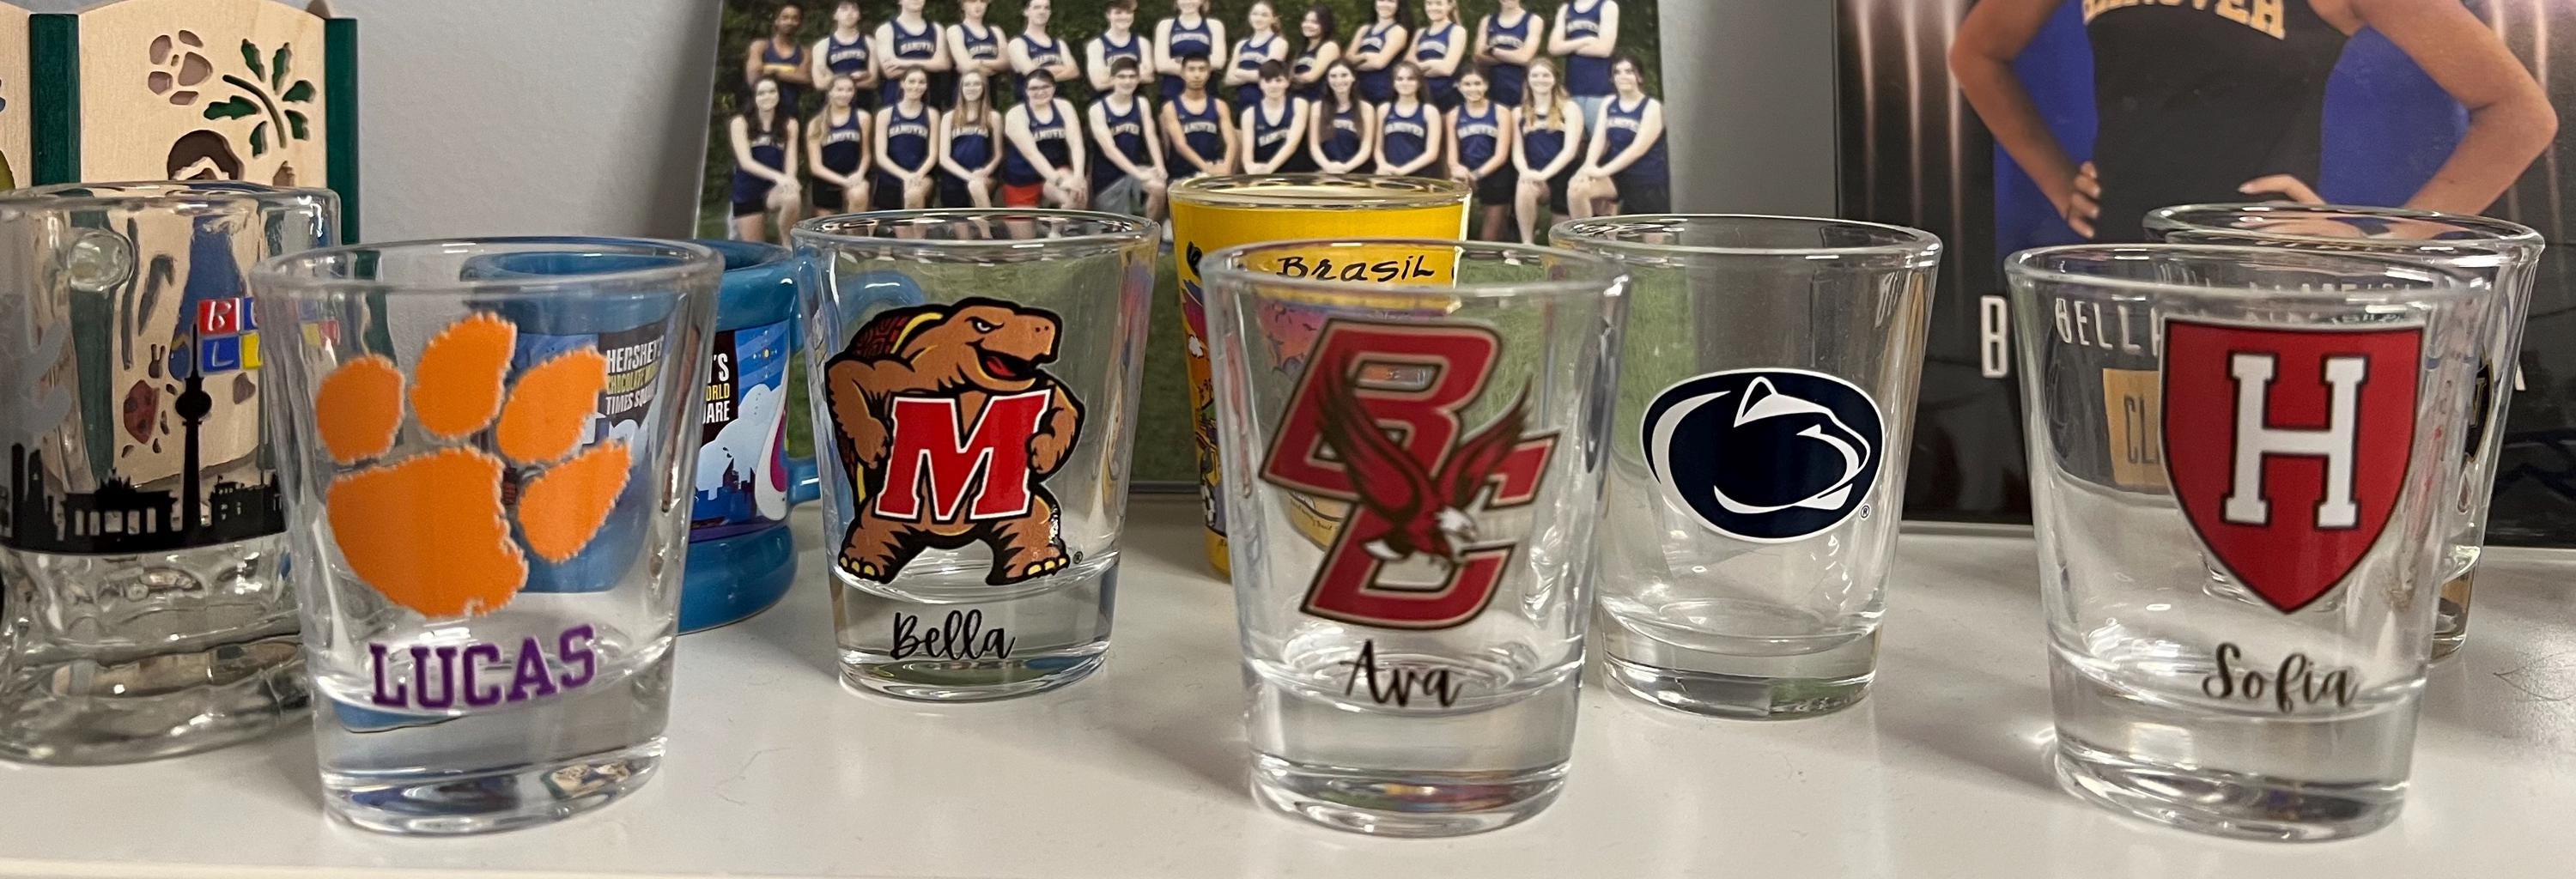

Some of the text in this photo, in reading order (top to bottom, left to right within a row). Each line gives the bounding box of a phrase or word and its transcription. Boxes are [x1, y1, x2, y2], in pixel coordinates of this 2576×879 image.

[605, 392, 634, 416] TIMES
[702, 400, 731, 425] ARE
[706, 383, 731, 403] ORLD
[875, 389, 1052, 521] M
[2223, 350, 2367, 530] H
[368, 623, 597, 708] LUCAS
[890, 609, 1015, 660] Bella
[1339, 639, 1463, 707] Ava
[2202, 642, 2359, 713] Sofia
